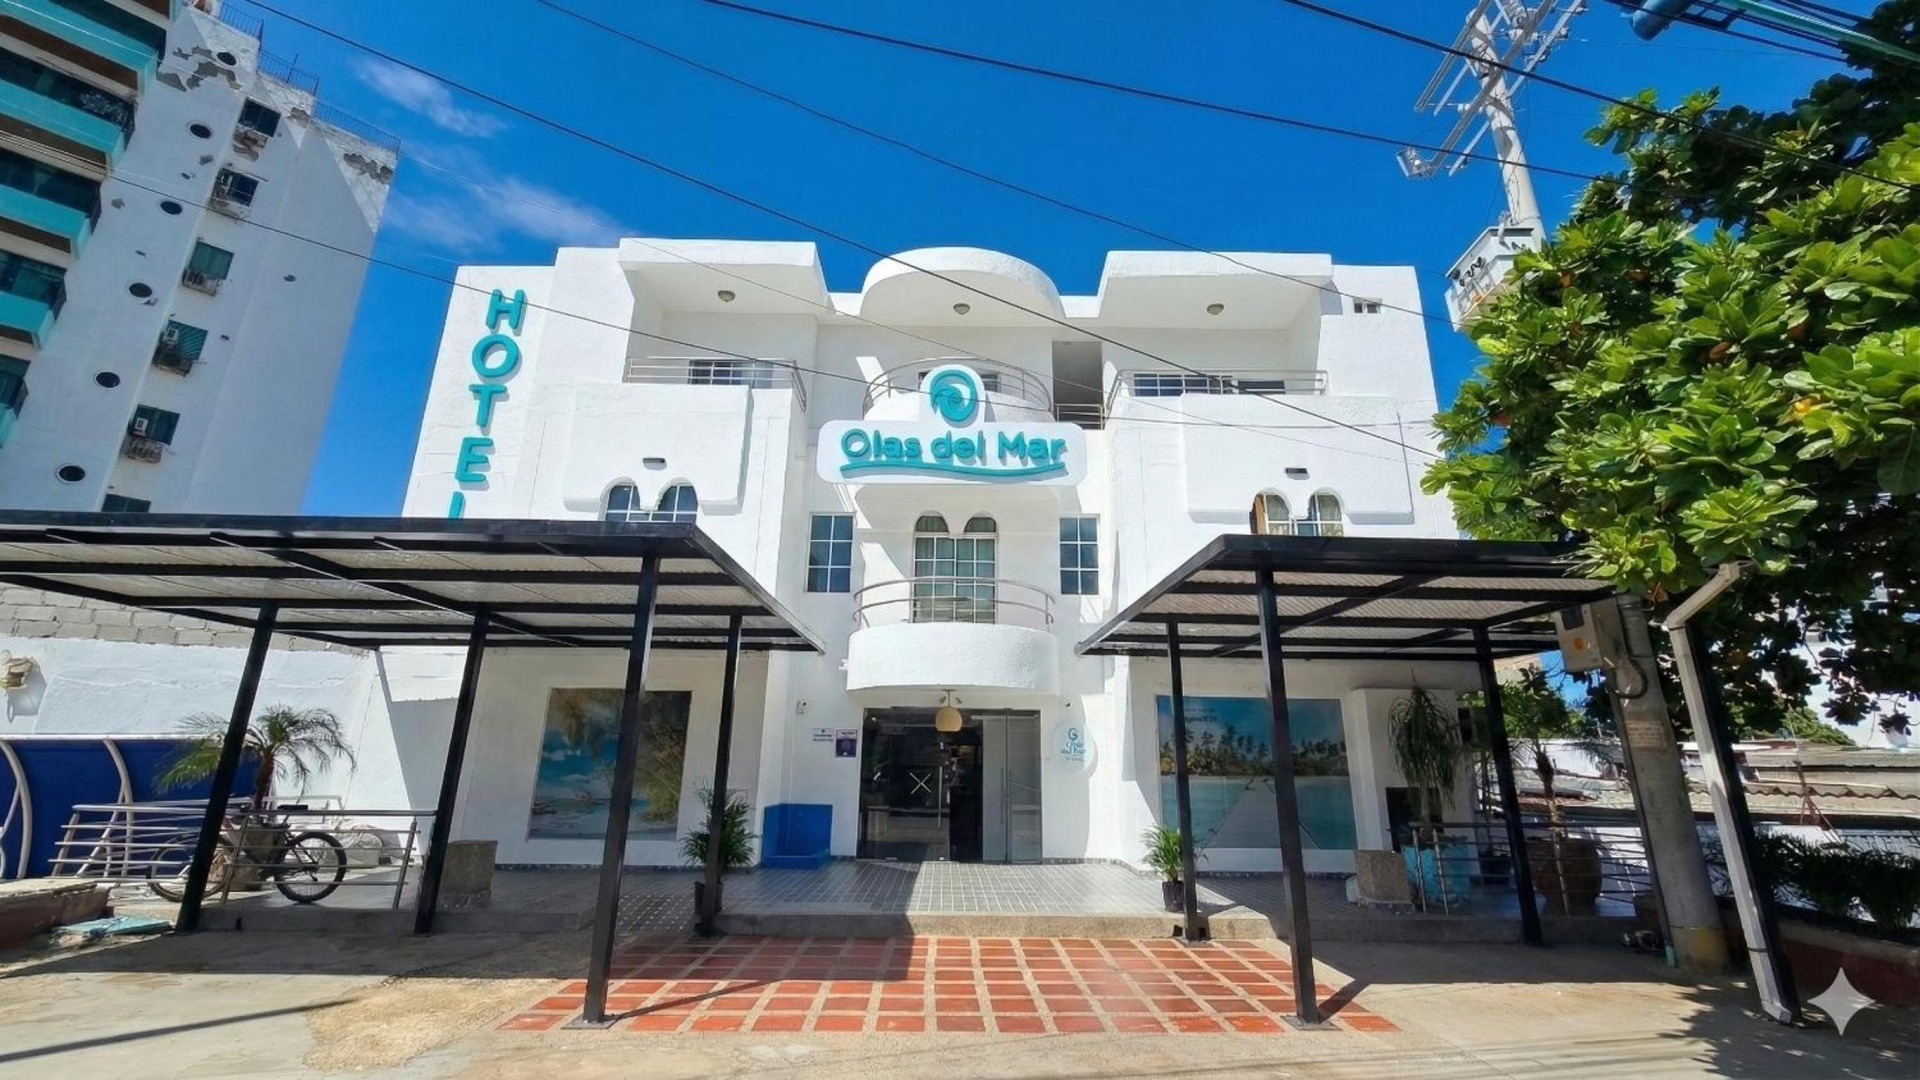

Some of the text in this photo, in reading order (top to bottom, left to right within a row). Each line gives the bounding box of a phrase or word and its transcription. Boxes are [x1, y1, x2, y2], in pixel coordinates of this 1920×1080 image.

[841, 428, 1066, 460] Olas del Mar
